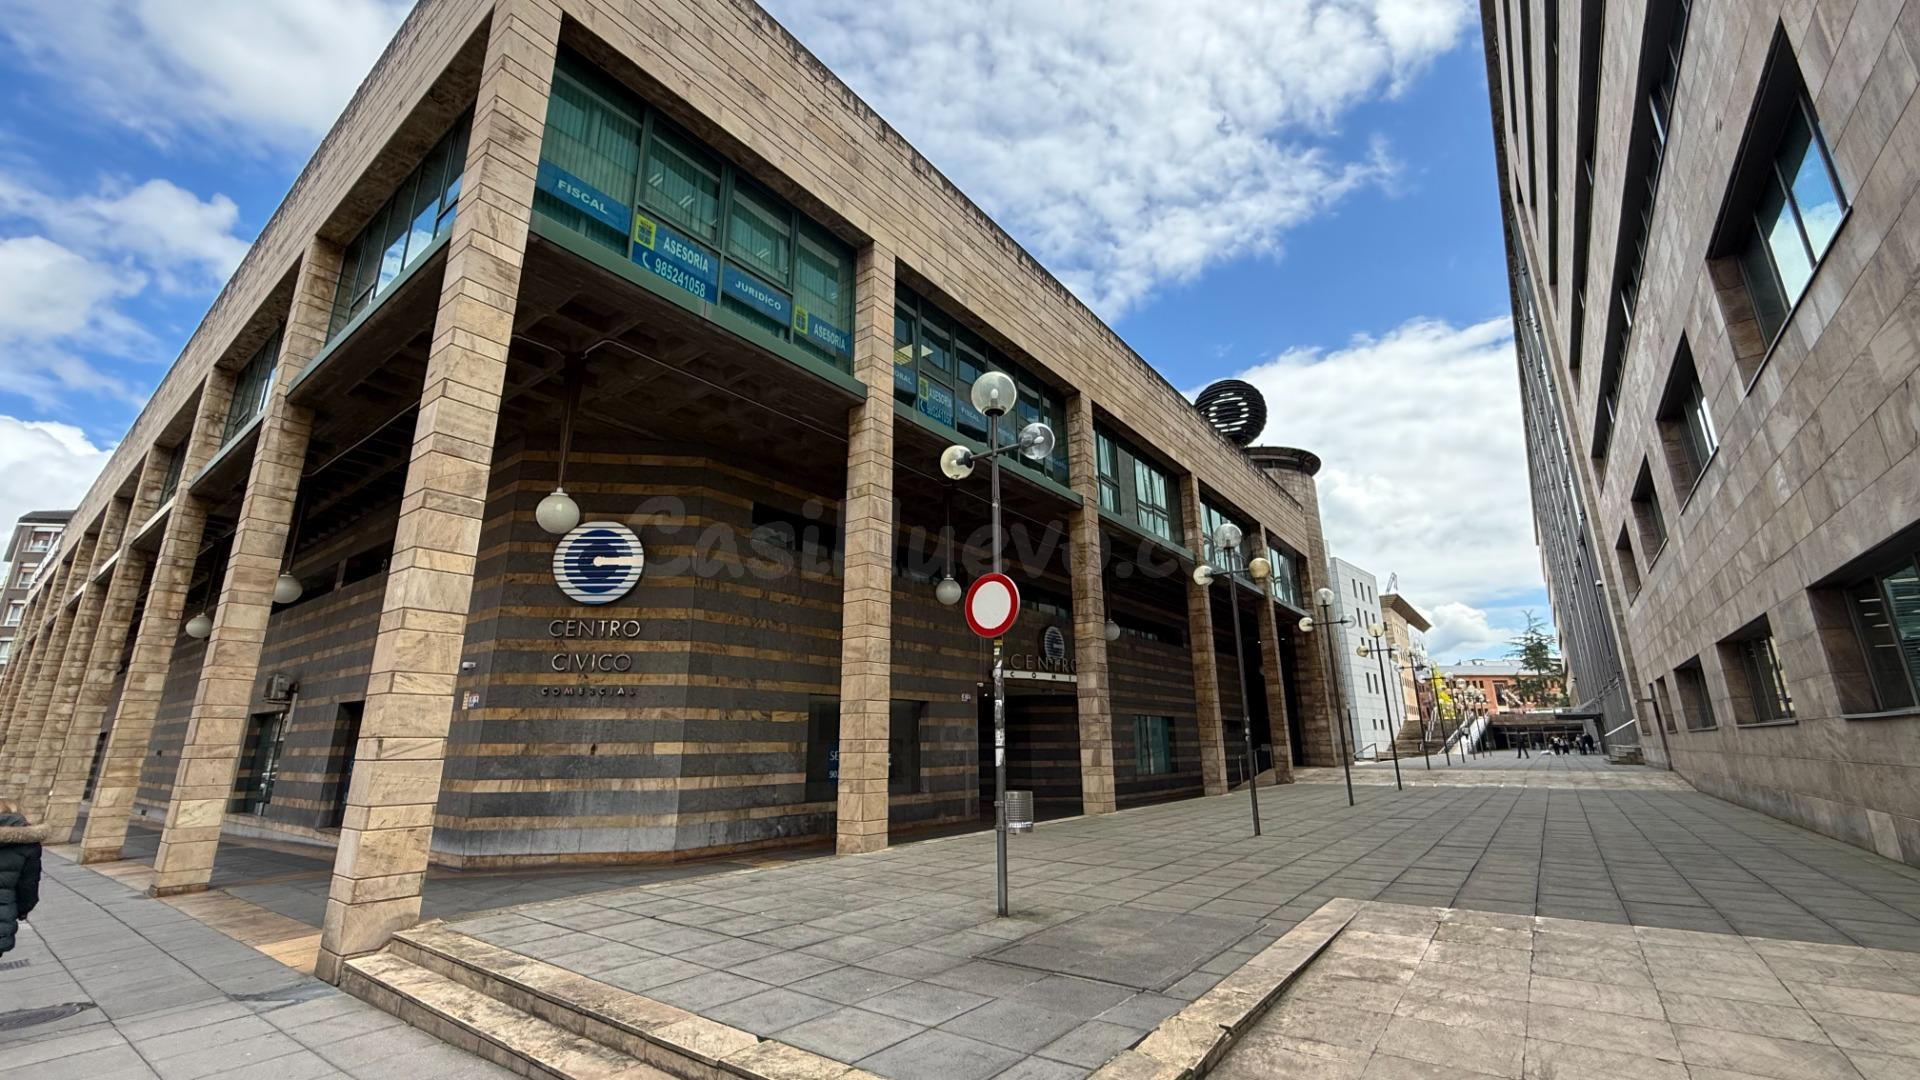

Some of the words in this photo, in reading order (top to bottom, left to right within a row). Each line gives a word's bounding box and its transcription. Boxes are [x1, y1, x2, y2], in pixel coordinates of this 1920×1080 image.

[557, 179, 608, 215] FISCAL
[663, 236, 709, 273] ASESORÍA
[655, 257, 706, 298] 985241058
[548, 619, 641, 638] CENTRO
[551, 653, 632, 672] CIVICO
